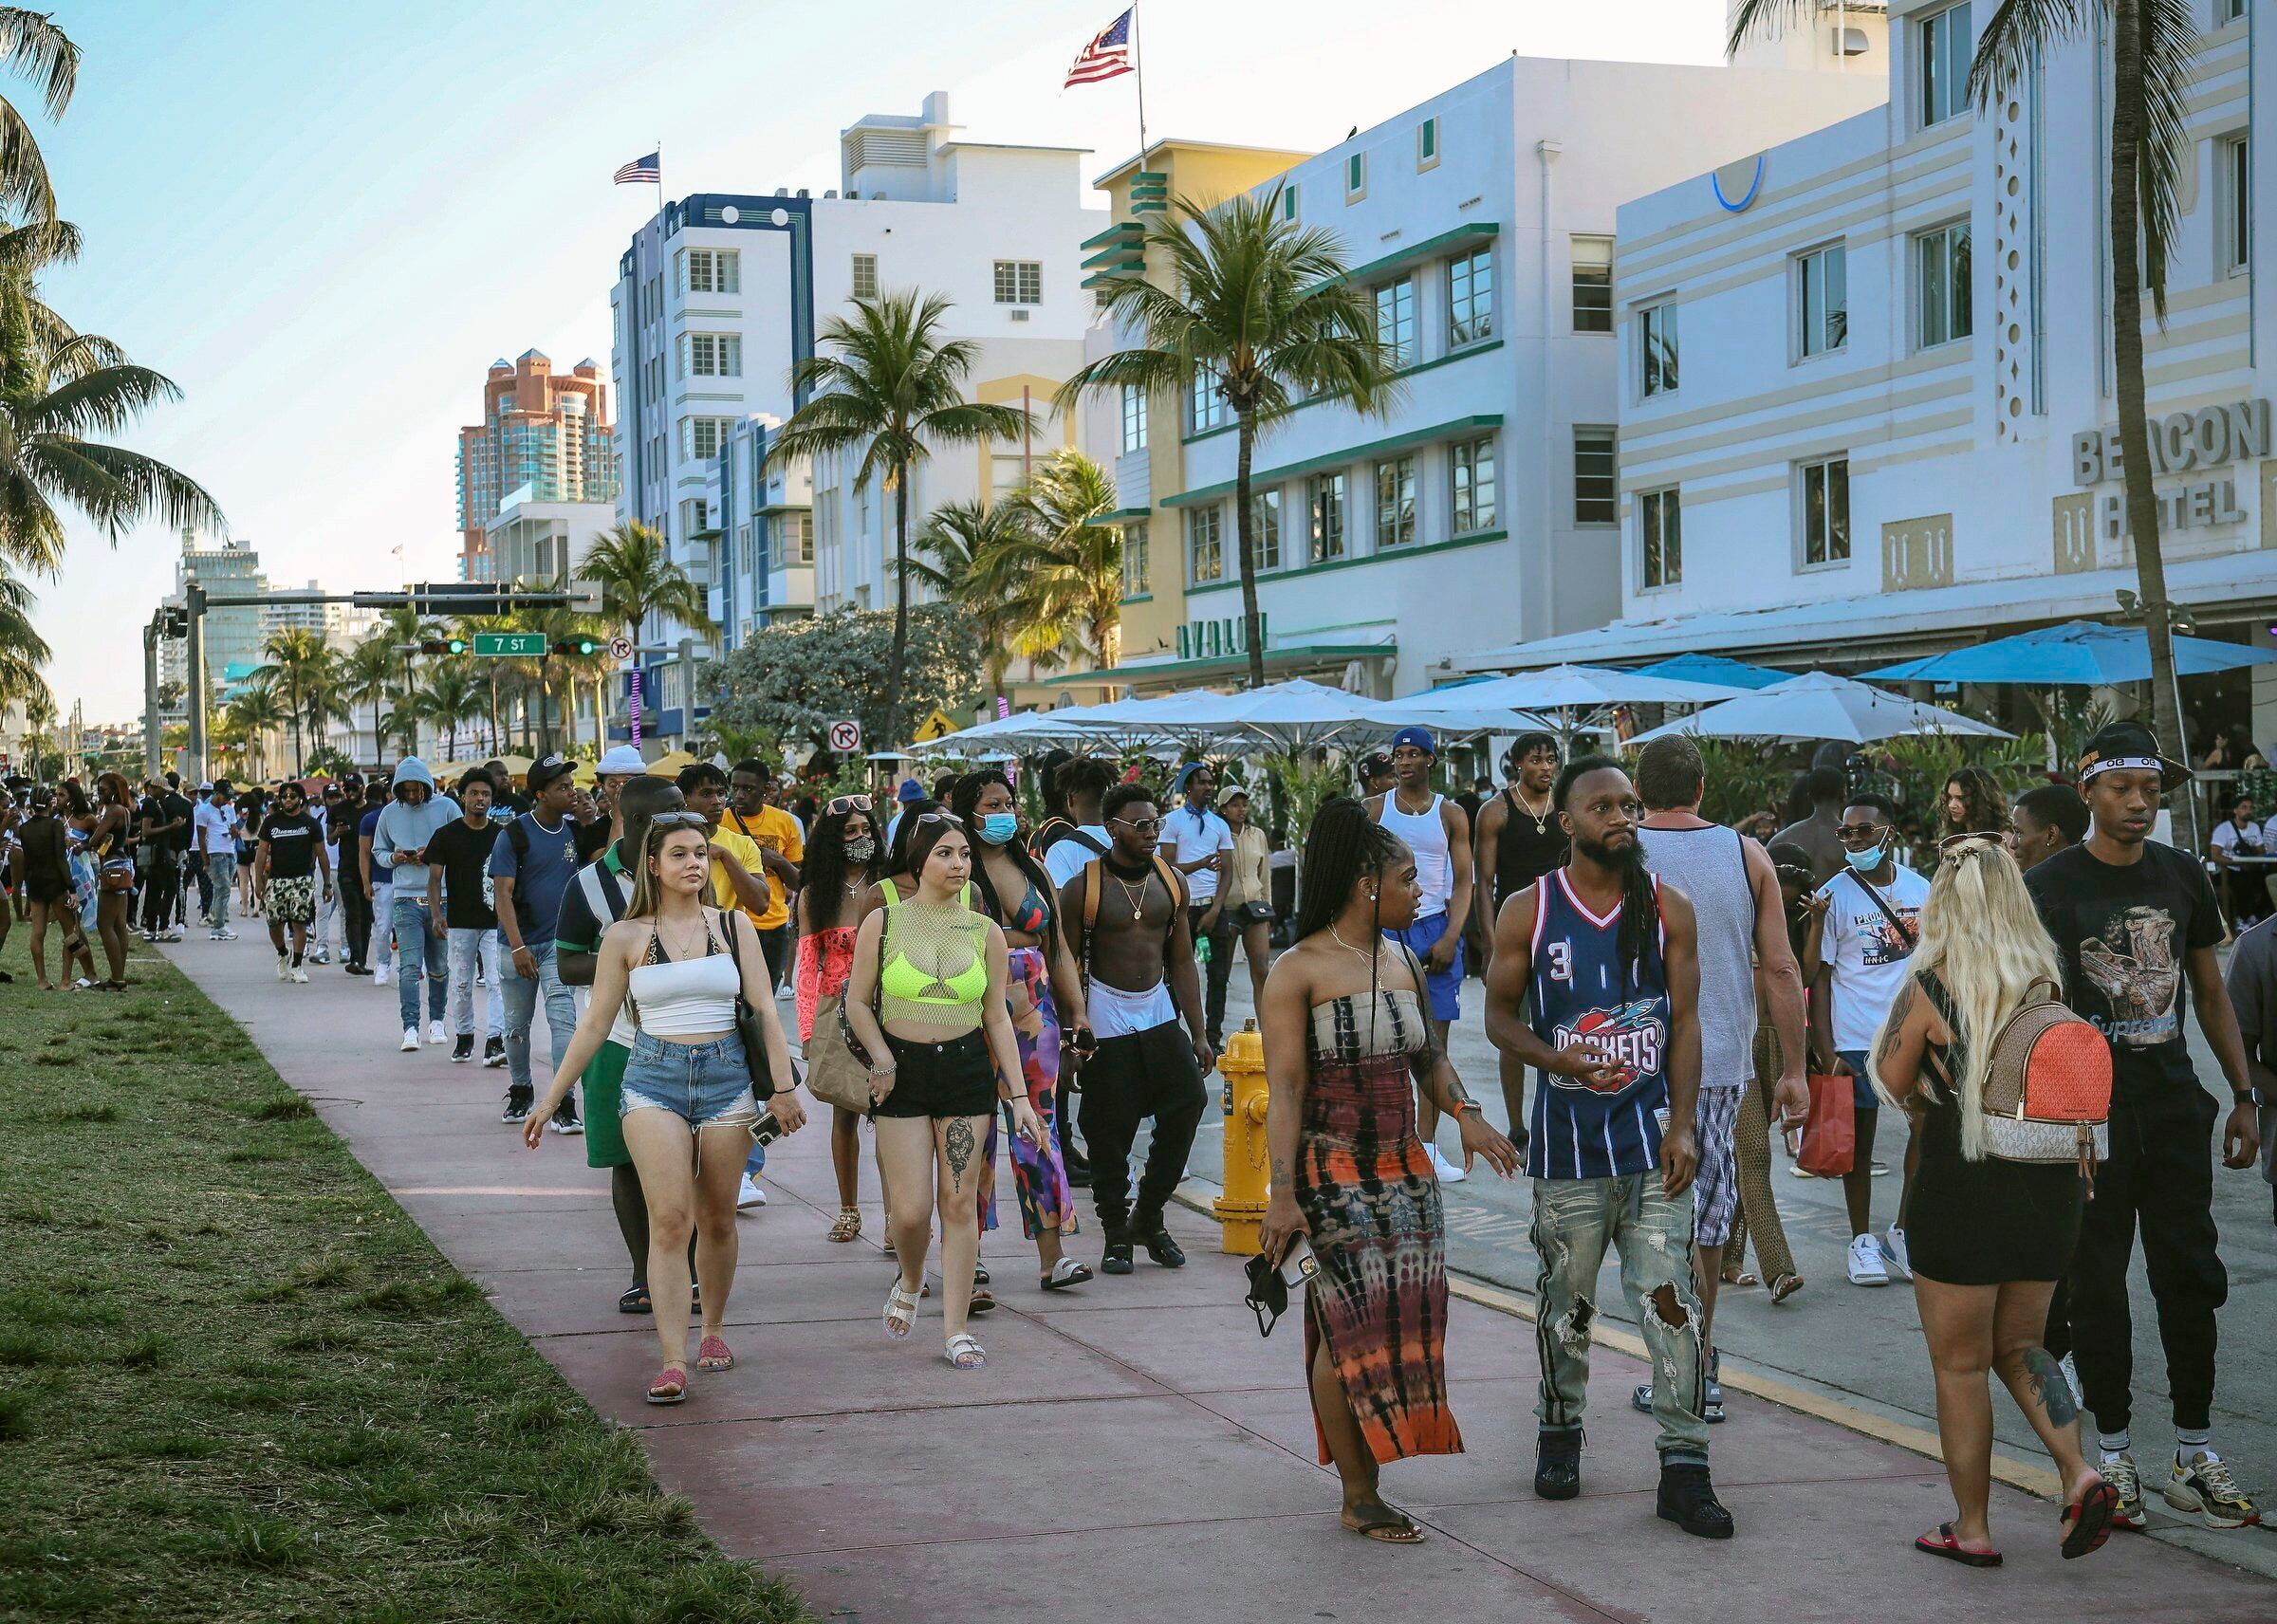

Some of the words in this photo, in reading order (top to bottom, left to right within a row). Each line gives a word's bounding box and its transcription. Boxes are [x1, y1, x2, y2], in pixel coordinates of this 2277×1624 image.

[2101, 481, 2248, 540] HTEL
[494, 637, 504, 652] 7
[510, 638, 526, 651] ST
[1548, 942, 1571, 981] 3
